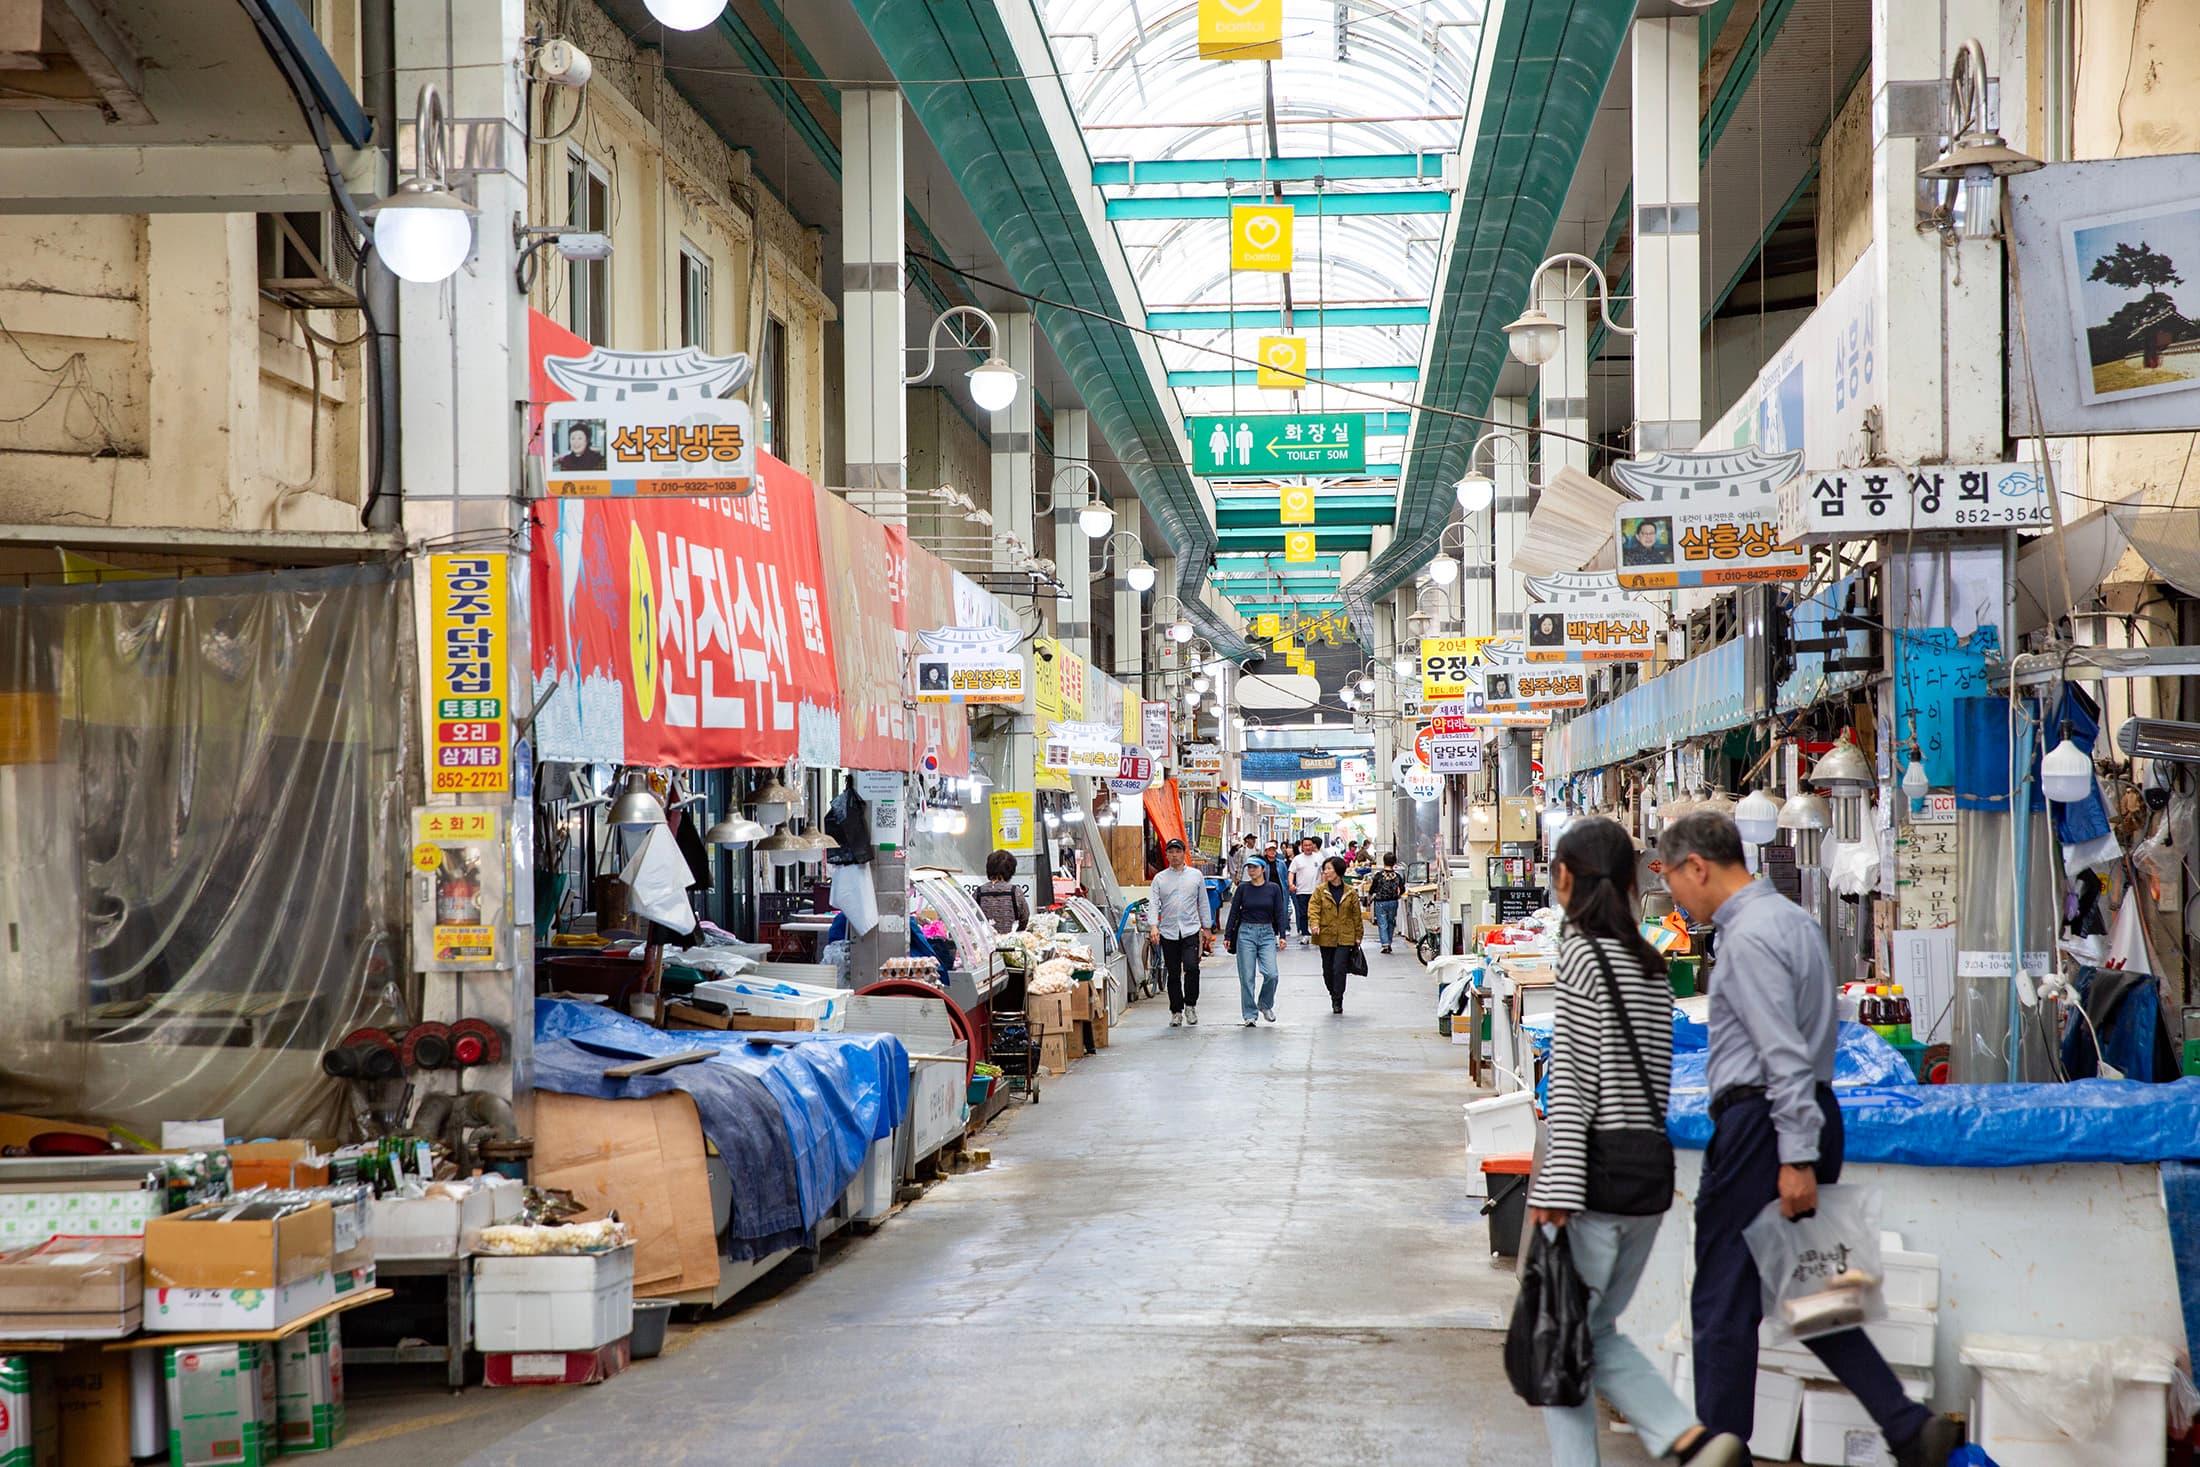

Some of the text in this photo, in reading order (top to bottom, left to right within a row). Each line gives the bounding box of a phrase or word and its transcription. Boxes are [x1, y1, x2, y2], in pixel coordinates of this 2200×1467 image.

[1285, 423, 1349, 443] 화장실
[611, 424, 744, 462] 선진냉동
[1287, 450, 1349, 461] TOILET 50M
[651, 481, 737, 493] T.010-9322-1038
[1811, 471, 1989, 517] 삼흥상회
[1737, 510, 1761, 520] 아니다
[1955, 506, 2053, 524] 852-3540
[1715, 568, 1798, 582] T.010-8425-8785
[446, 559, 494, 693] 공주닭집
[657, 531, 796, 732] 선진수산
[1567, 619, 1650, 644] 백제수산
[1438, 641, 1467, 653] 20년
[951, 669, 1022, 689] 삼일정육점
[1519, 675, 1583, 698] 청주상회
[442, 700, 498, 719] 토종닭
[451, 724, 488, 743] 오리
[442, 748, 499, 767] 삼계닭
[1434, 744, 1478, 760] 달달도넛
[1120, 757, 1149, 779] 어물
[436, 772, 504, 789] 852-2721
[1413, 785, 1435, 797] 식당
[429, 816, 485, 831] 소화기
